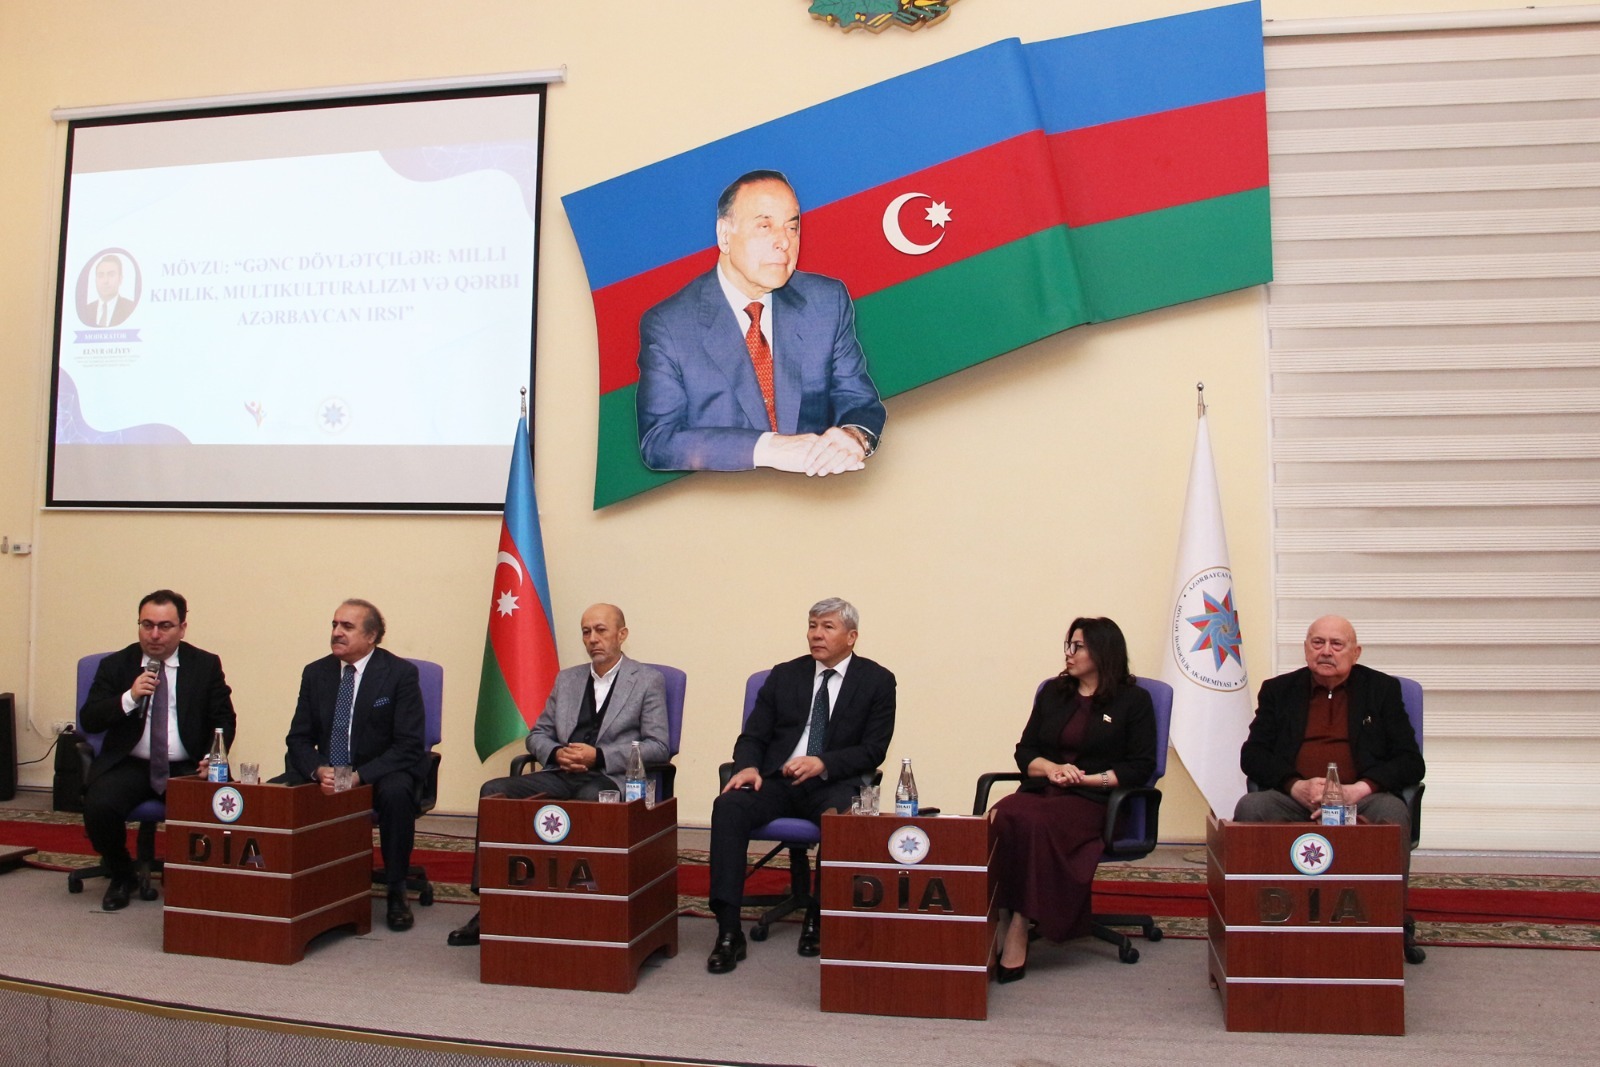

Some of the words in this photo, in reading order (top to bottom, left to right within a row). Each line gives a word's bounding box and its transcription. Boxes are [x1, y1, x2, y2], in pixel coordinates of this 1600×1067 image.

[161, 259, 229, 277] MÖVZU:
[448, 246, 507, 264] MILLI
[150, 286, 219, 303] KIMLIK,
[223, 277, 416, 299] MULTIKULTURALIZM
[422, 276, 449, 291] VƏ
[454, 273, 519, 293] QƏRBI
[236, 307, 361, 326] AZƏRBAYCAN
[1191, 671, 1232, 687] AKADEMİYASI
[852, 870, 955, 913] DİA
